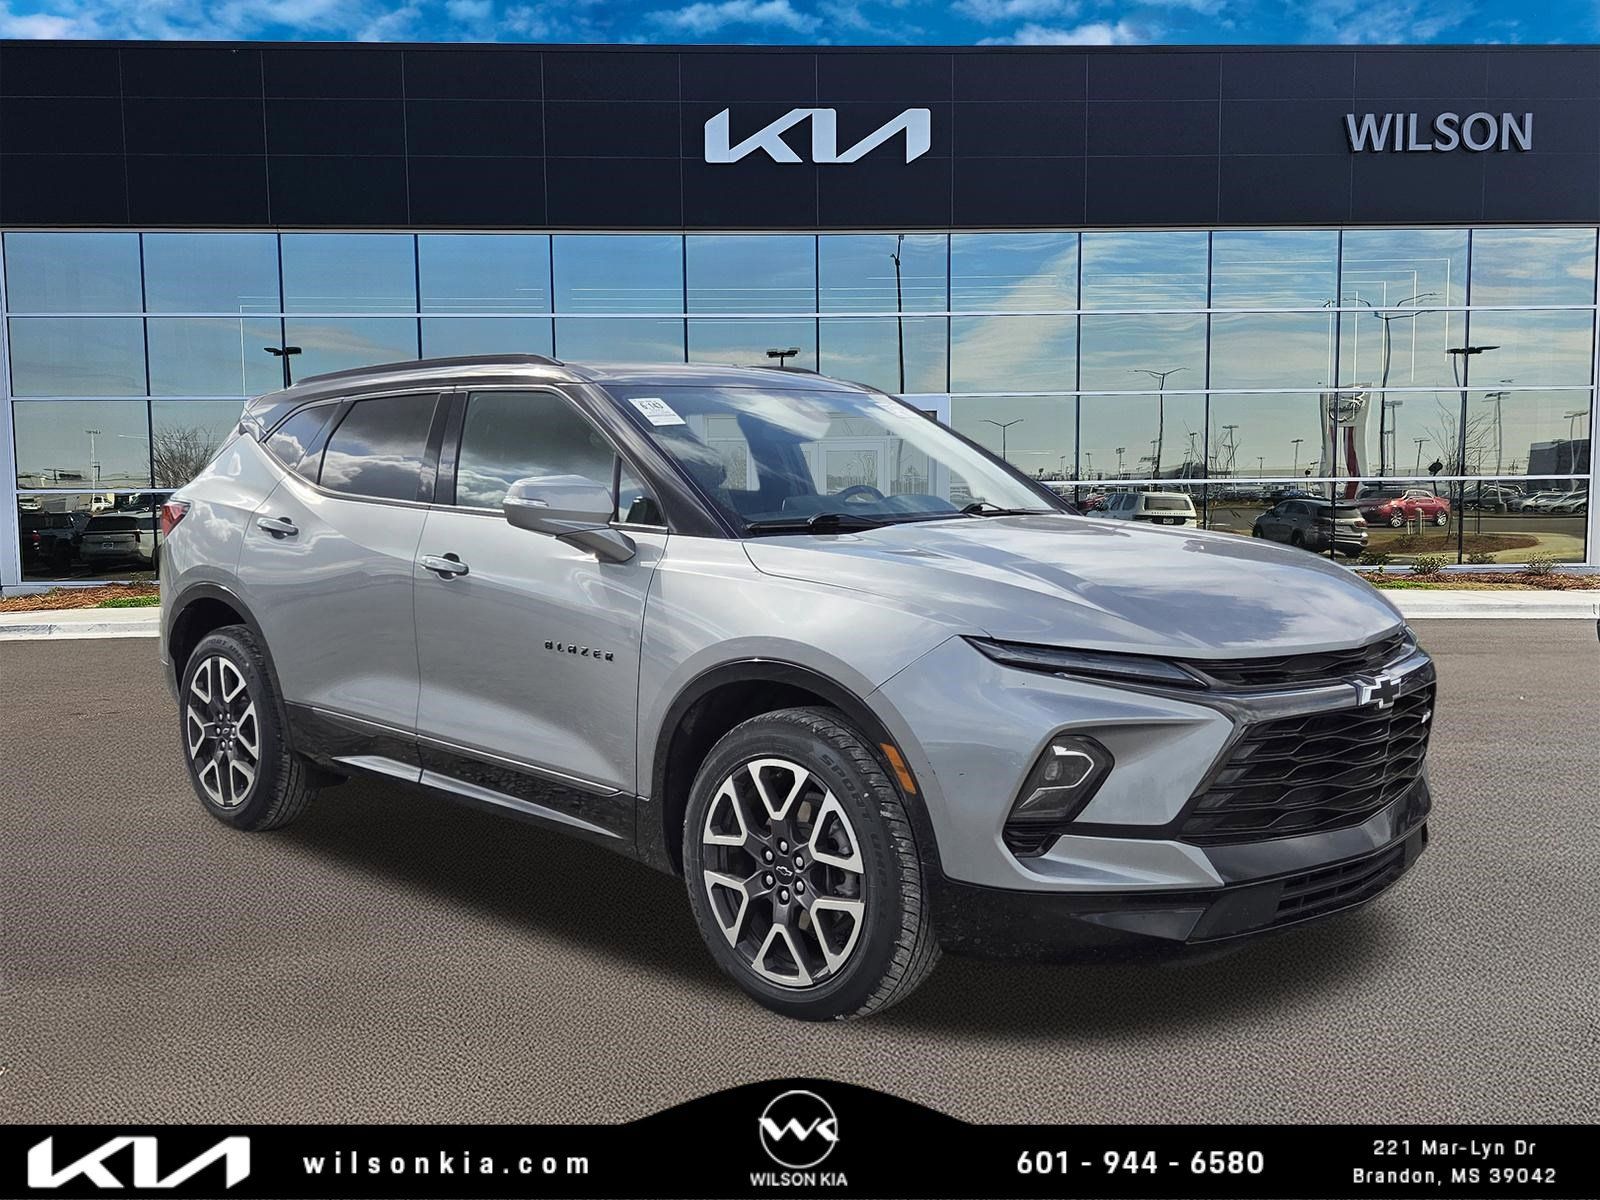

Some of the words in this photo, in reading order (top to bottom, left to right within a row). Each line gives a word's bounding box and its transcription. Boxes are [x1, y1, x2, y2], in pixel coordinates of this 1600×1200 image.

[705, 108, 931, 164] KIA
[1346, 112, 1534, 152] WILSON
[544, 640, 614, 662] BLAZER
